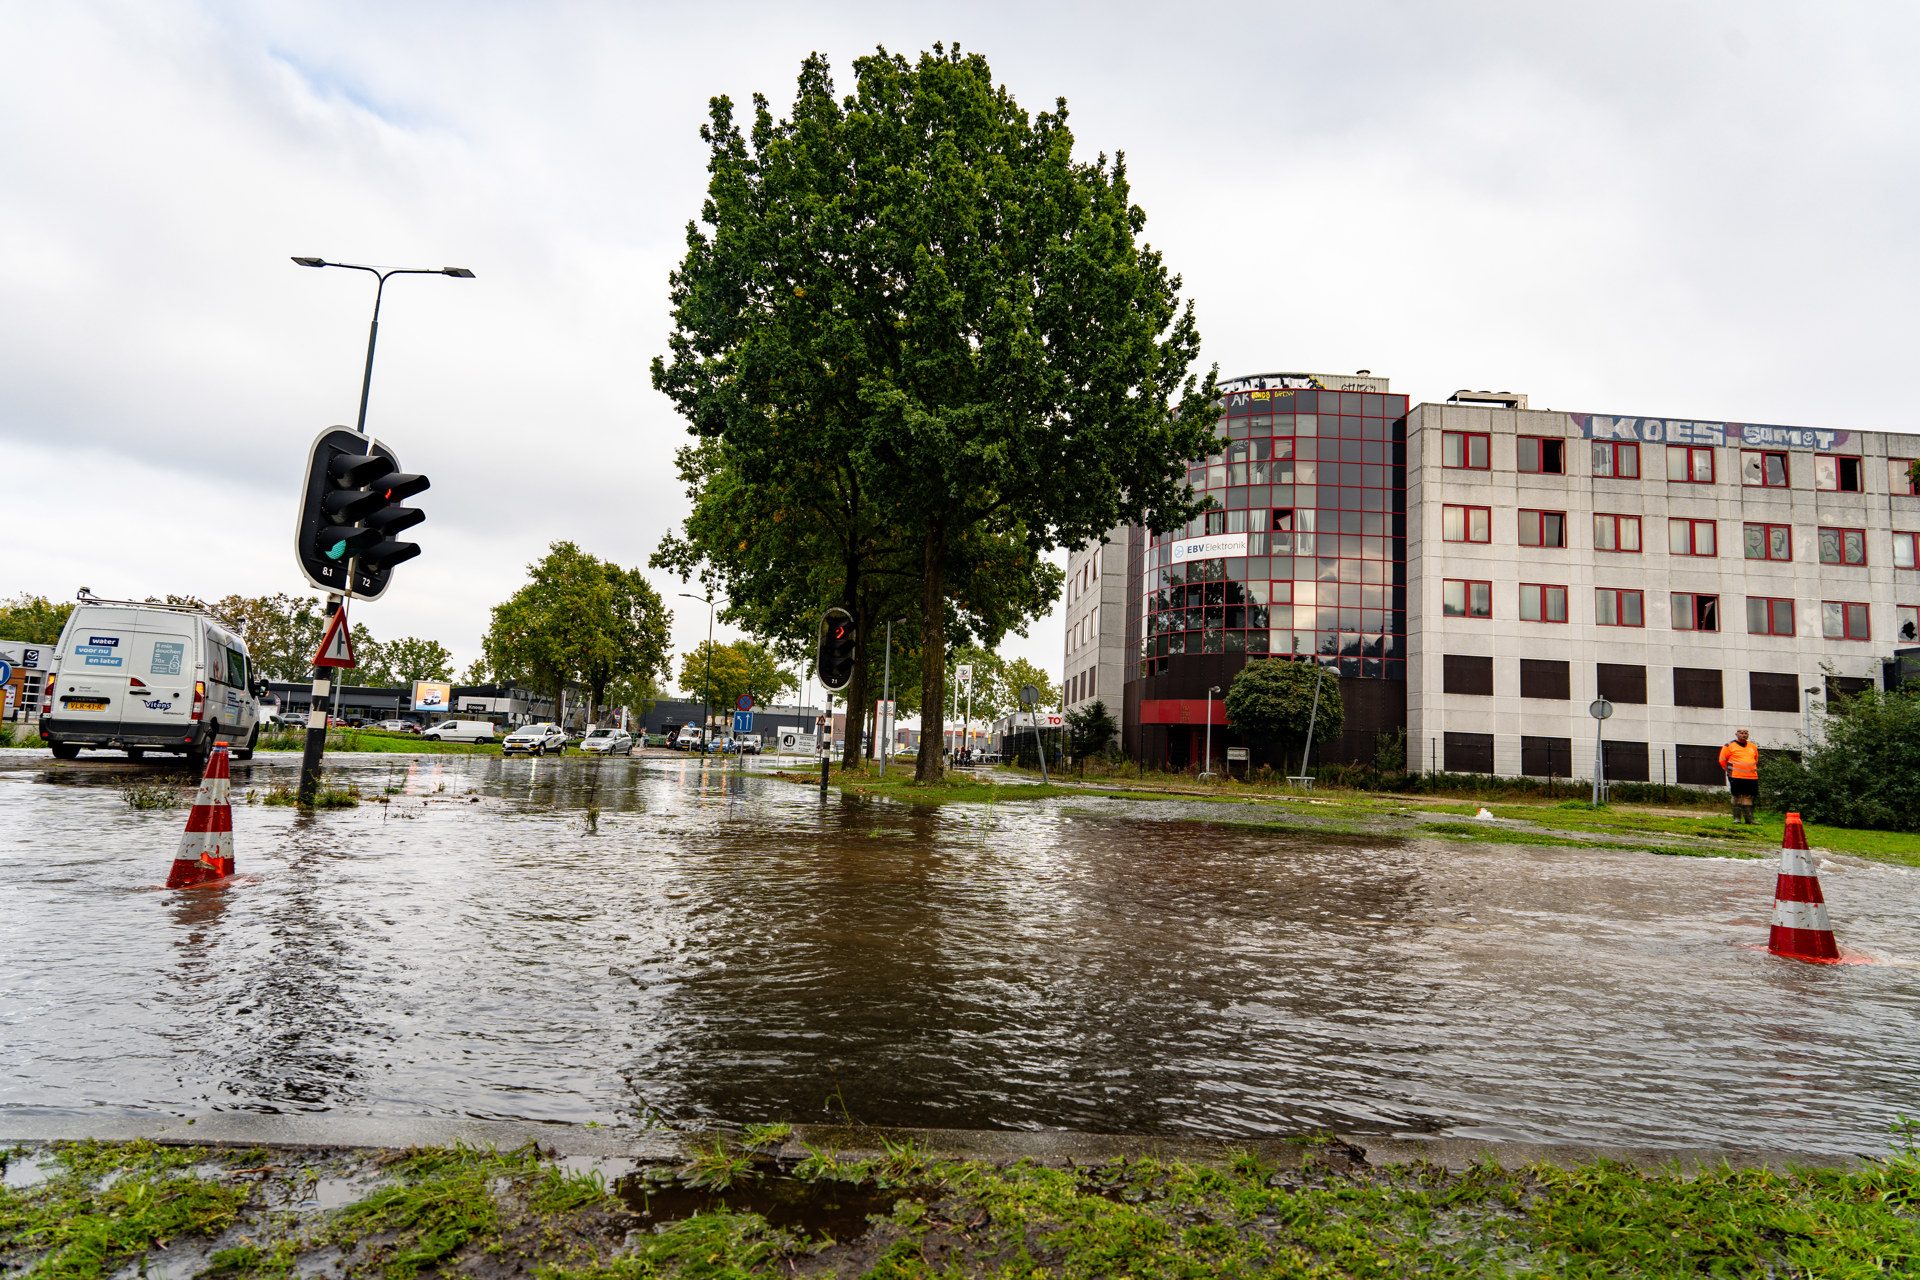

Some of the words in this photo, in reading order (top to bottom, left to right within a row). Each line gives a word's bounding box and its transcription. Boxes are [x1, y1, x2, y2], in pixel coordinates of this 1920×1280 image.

[1187, 544, 1205, 554] EBV
[1205, 541, 1246, 551] Elektronik
[322, 566, 333, 577] 8.1
[143, 699, 172, 711] Vitens
[1047, 716, 1062, 725] TO
